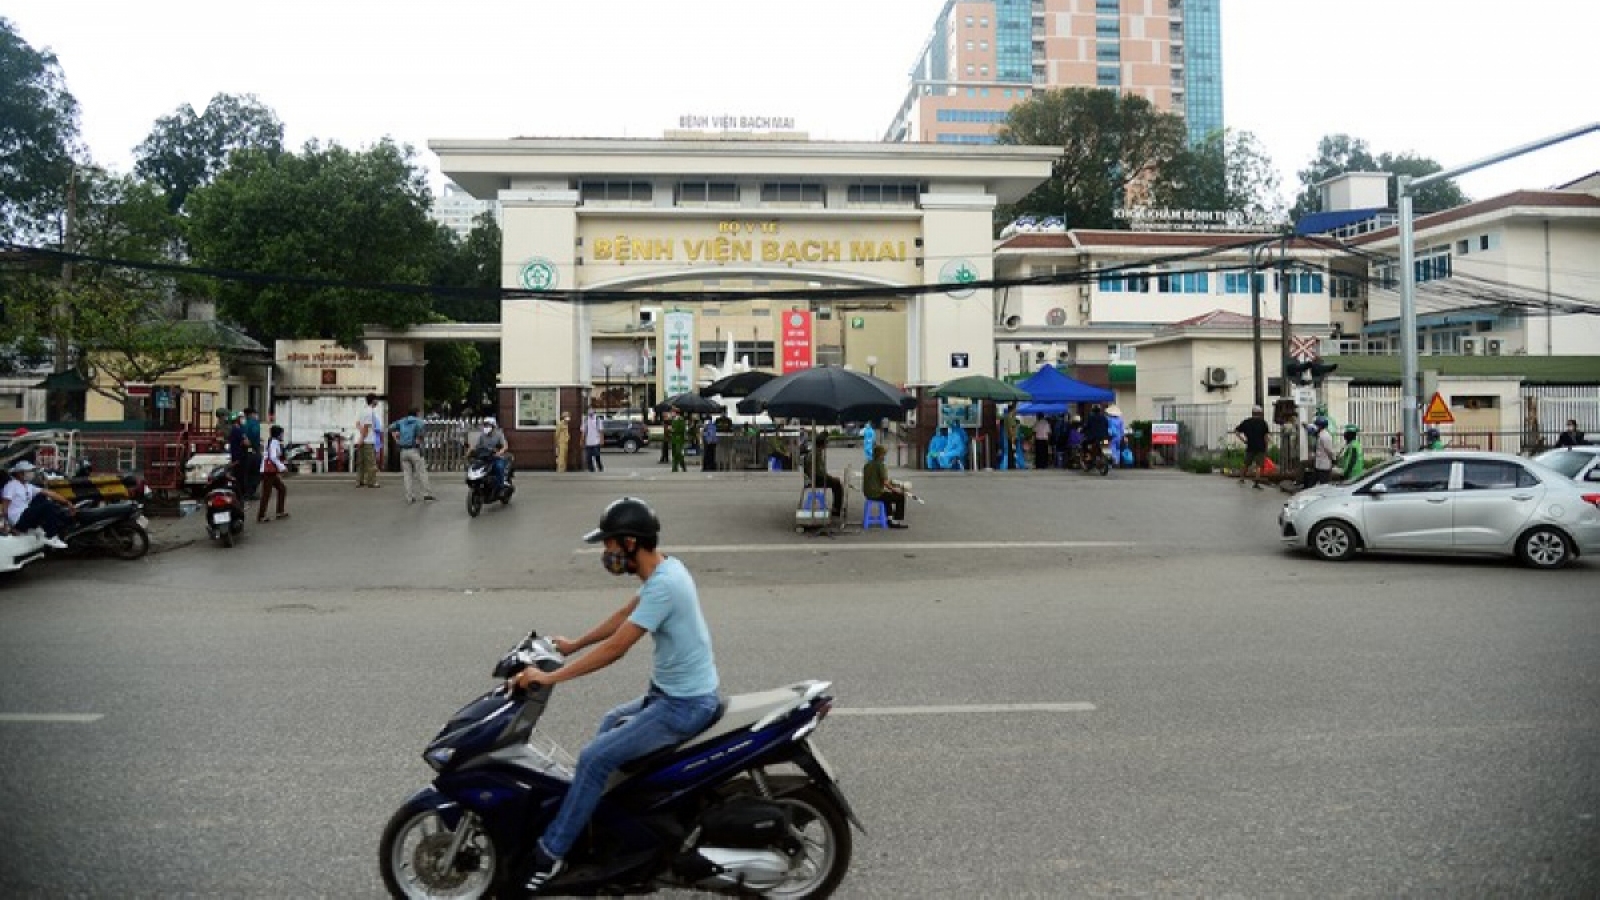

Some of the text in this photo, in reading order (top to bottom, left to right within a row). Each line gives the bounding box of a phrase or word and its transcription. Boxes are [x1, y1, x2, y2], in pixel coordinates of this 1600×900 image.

[719, 219, 741, 236] BỘ
[745, 221, 756, 233] Y
[593, 233, 906, 268] BỆNH VIỆN BẠCH MAI
